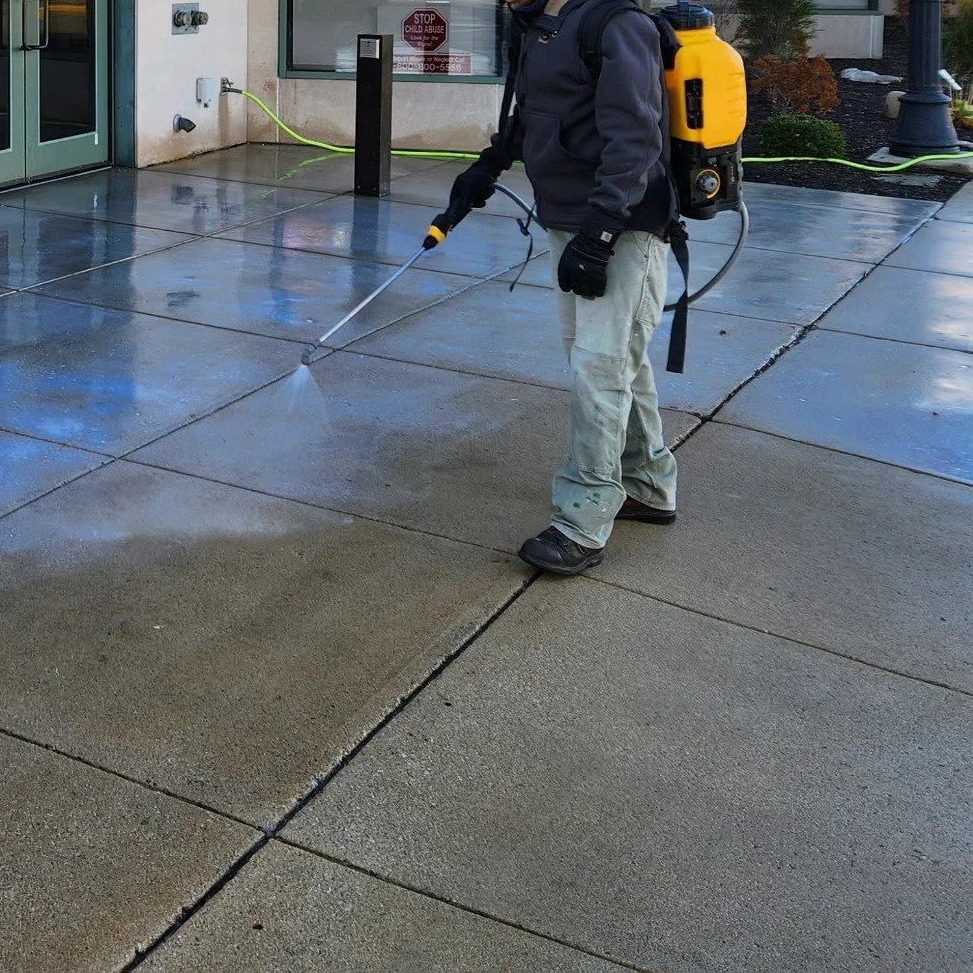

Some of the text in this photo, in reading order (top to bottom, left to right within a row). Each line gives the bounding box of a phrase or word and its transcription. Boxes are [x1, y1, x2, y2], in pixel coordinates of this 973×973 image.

[413, 13, 436, 25] STOP
[404, 25, 445, 34] CHILD ABUSE
